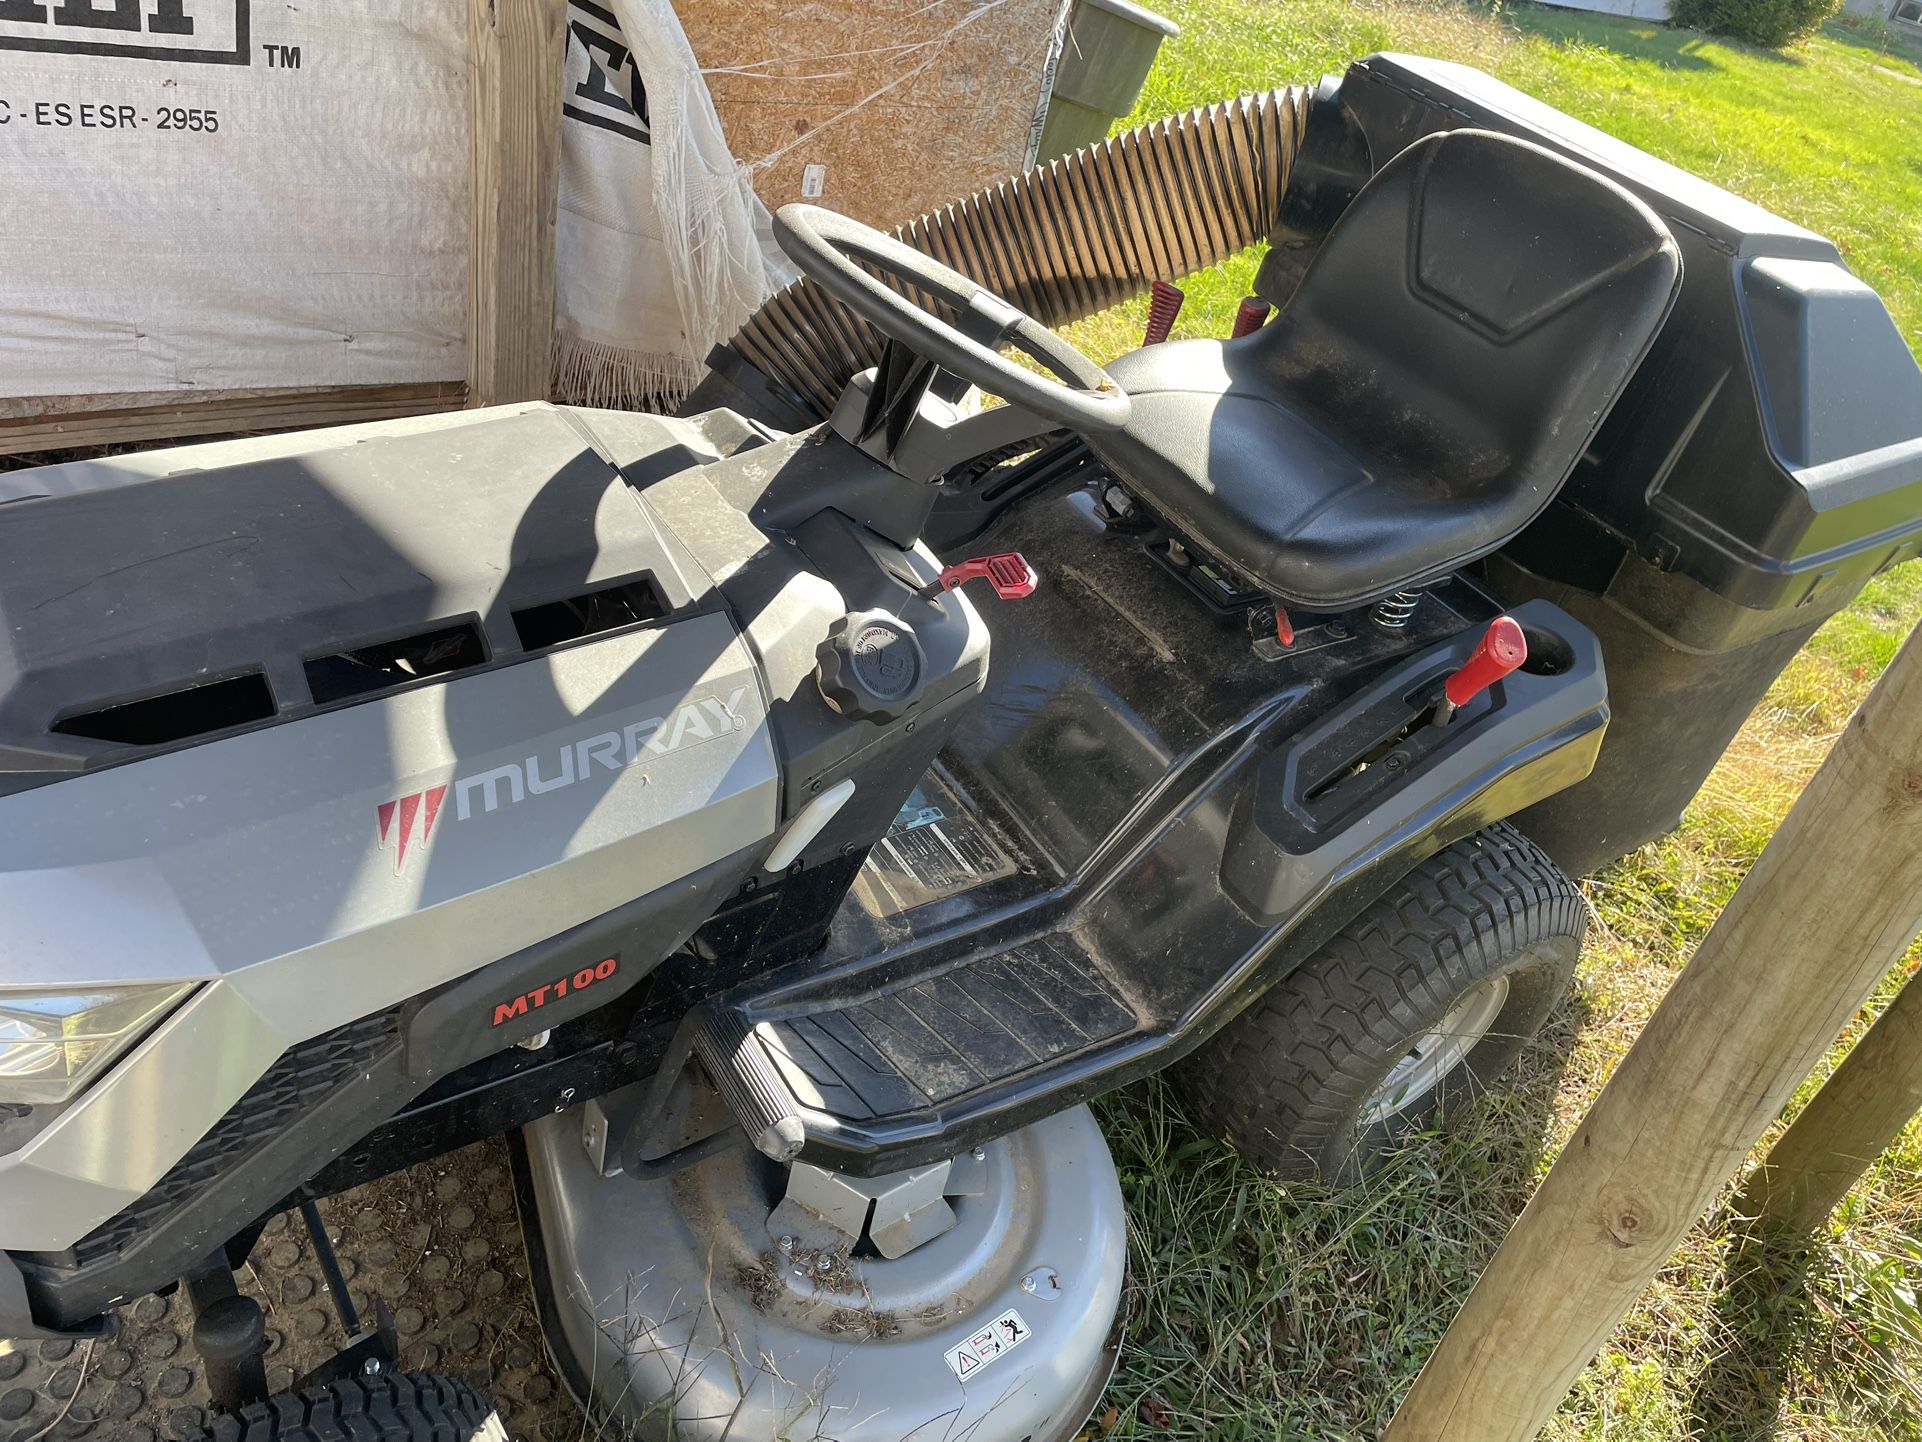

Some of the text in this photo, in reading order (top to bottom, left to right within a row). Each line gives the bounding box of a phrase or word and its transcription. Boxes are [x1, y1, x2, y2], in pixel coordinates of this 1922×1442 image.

[262, 44, 301, 69] TM
[455, 687, 748, 821] MURRAY
[493, 958, 617, 1026] MT100
